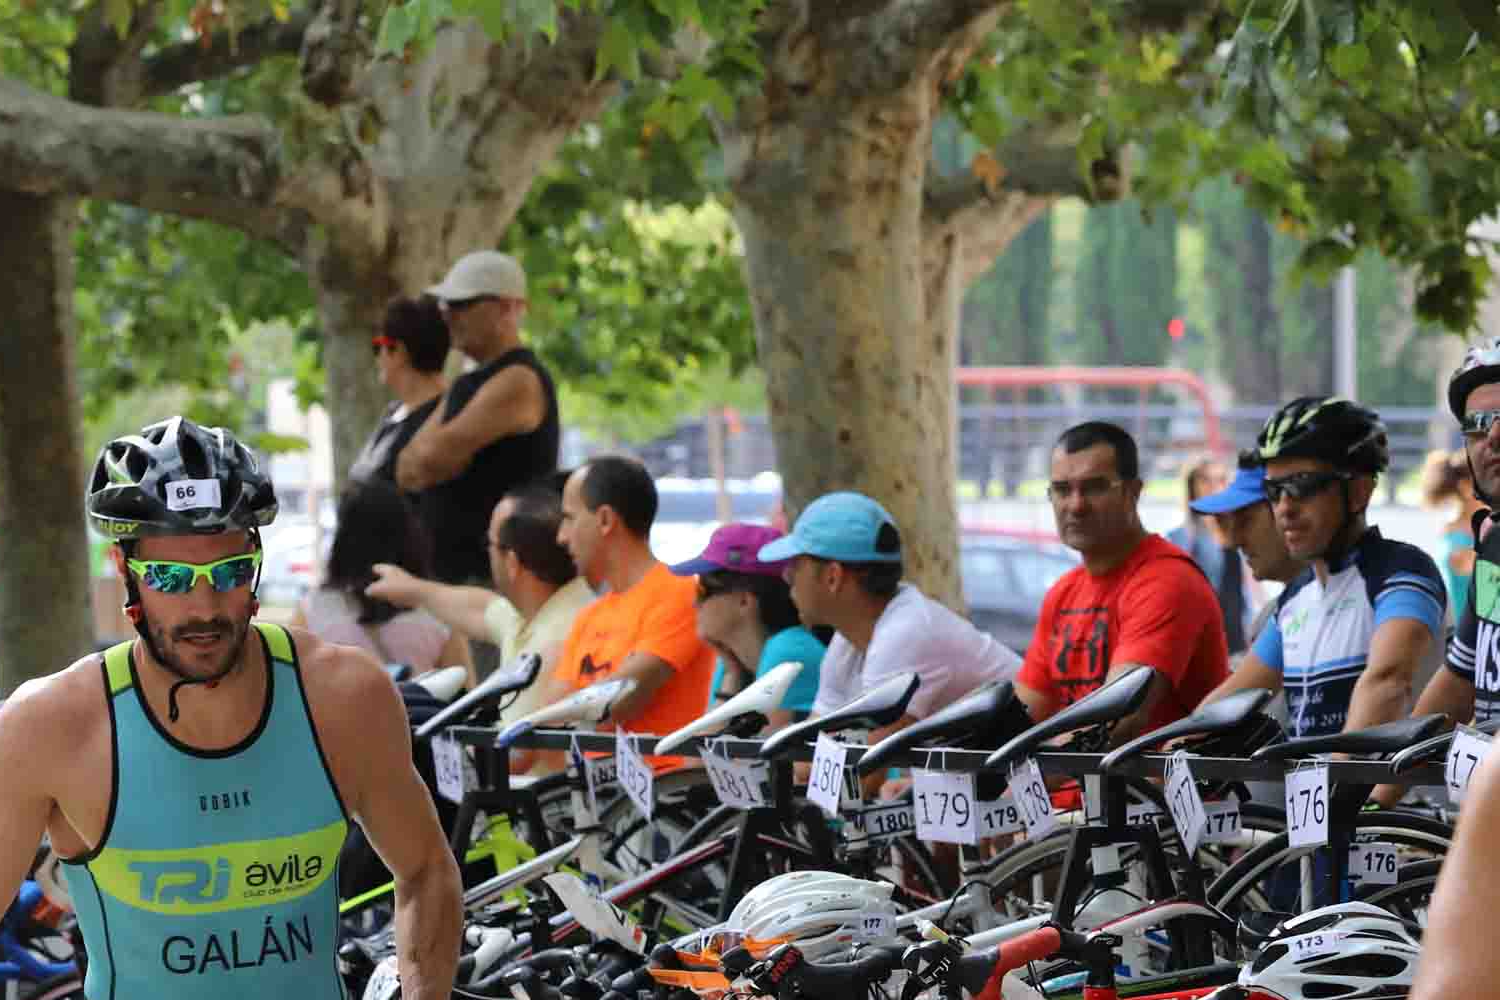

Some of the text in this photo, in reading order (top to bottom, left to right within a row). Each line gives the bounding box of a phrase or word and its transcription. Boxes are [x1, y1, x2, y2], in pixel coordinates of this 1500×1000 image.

[175, 486, 196, 499] 66
[710, 765, 756, 803] 181
[811, 756, 841, 797] 180
[1452, 752, 1478, 789] 17
[874, 811, 909, 835] 180
[917, 792, 970, 828] 179
[983, 805, 1018, 830] 179
[1288, 785, 1325, 831] 176
[1364, 852, 1396, 874] 176
[863, 918, 882, 929] 177
[161, 913, 314, 975] GALÁN
[1295, 934, 1324, 948] 173
